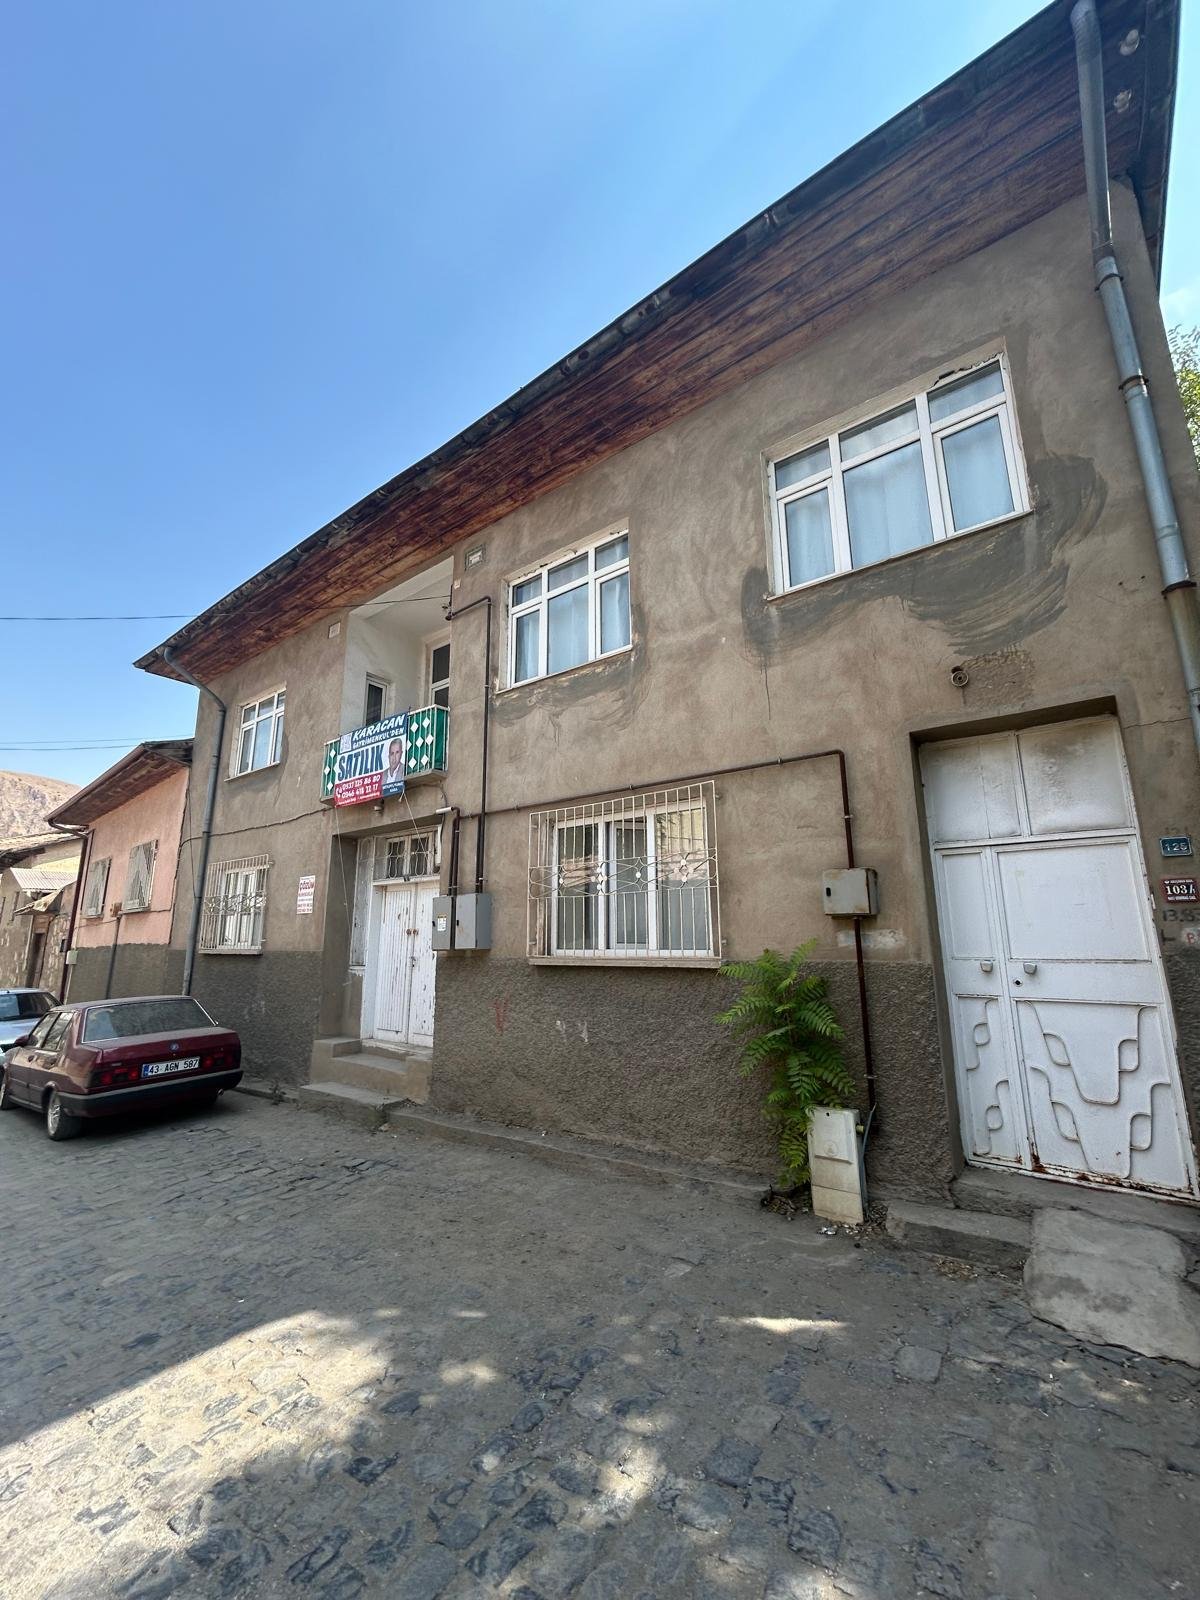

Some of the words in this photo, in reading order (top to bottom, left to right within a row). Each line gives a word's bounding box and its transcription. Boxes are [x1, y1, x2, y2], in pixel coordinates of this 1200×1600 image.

[352, 714, 406, 741] KARACAN
[337, 743, 385, 782] SATILIK
[149, 1065, 160, 1074] 43
[165, 1062, 179, 1072] AGN
